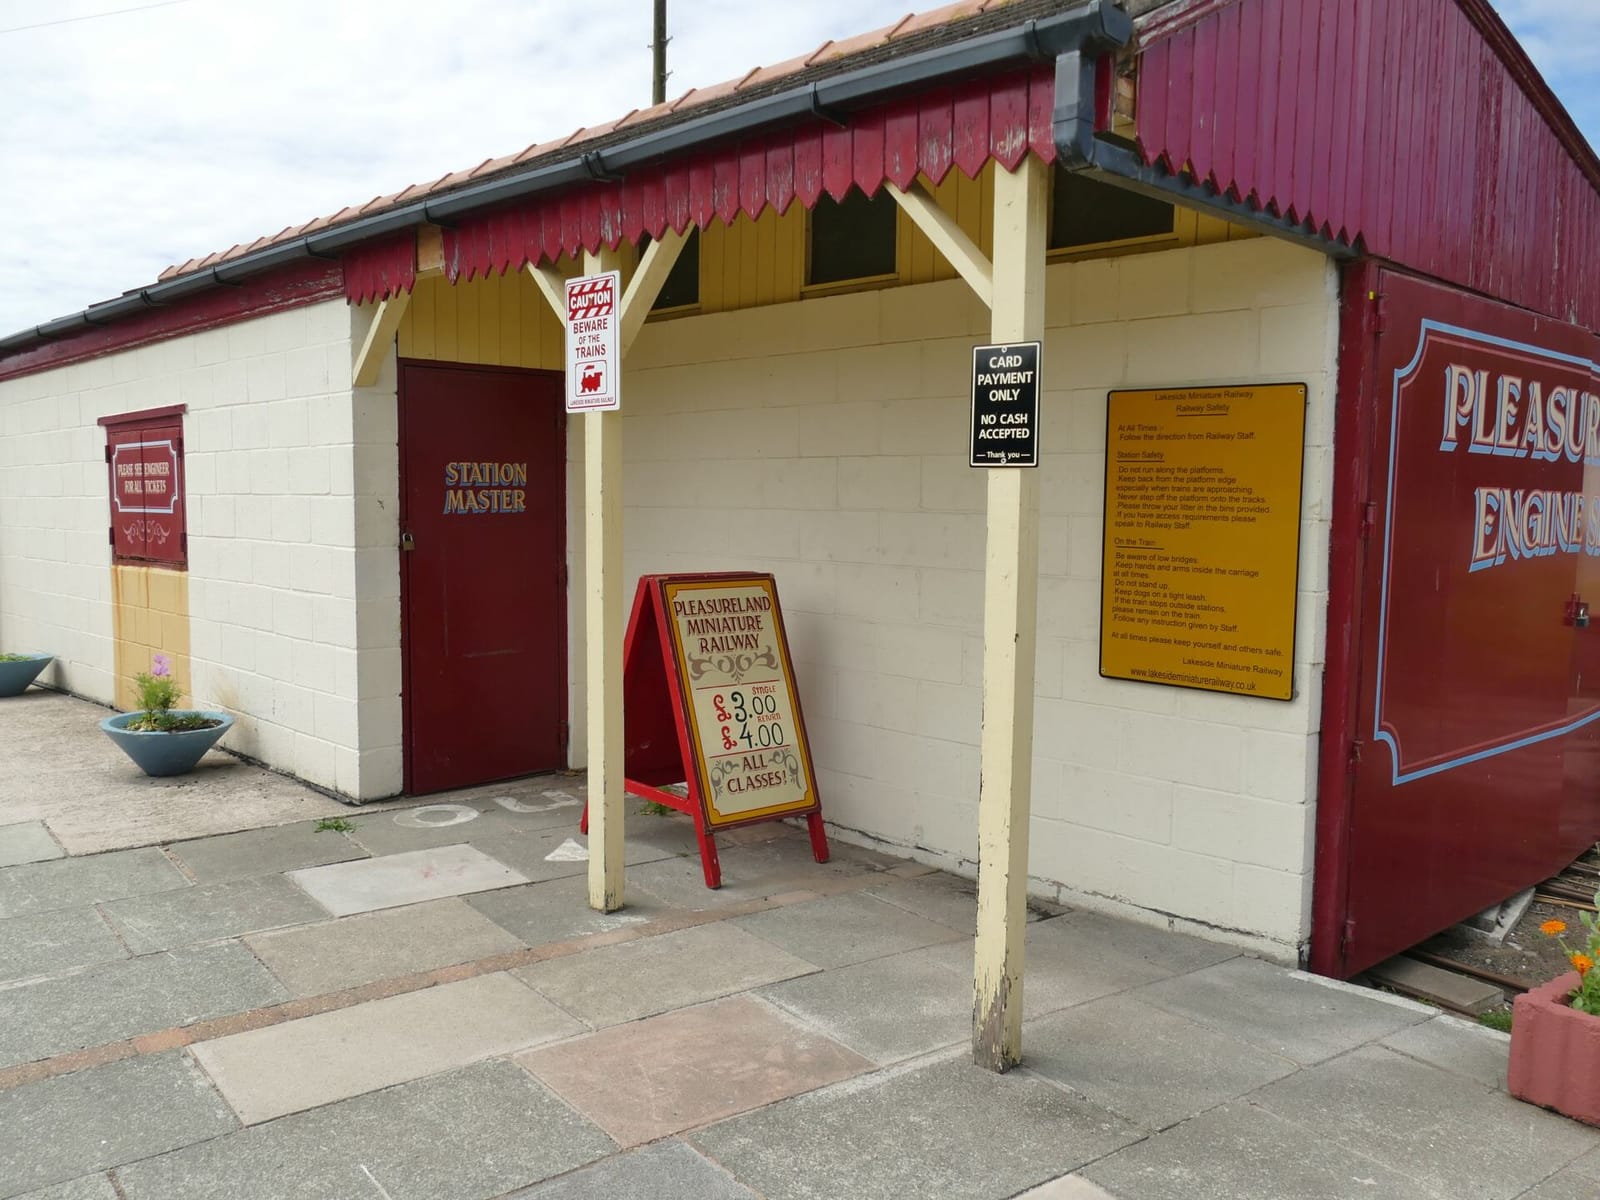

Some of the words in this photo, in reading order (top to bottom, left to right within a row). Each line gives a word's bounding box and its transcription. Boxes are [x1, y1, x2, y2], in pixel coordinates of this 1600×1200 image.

[570, 292, 611, 310] CAUTION
[573, 318, 608, 334] BEWARE
[578, 336, 587, 345] OF
[588, 334, 600, 344] THE
[576, 344, 606, 359] TRAINS
[989, 355, 1022, 368] CARD
[978, 371, 1033, 386] PAYMENT
[989, 389, 1020, 402] ONLY
[1224, 390, 1253, 400] Railway
[1176, 404, 1204, 413] Railway
[1206, 403, 1230, 412] Safety
[981, 414, 996, 424] NO
[1000, 413, 1028, 424] CASH
[978, 428, 1030, 439] ACCEPTED
[1156, 432, 1185, 440] direction
[1206, 432, 1234, 441] Railway
[1008, 452, 1020, 460] you
[1141, 451, 1164, 459] Safety
[445, 462, 528, 486] STATION
[1155, 466, 1175, 474] along
[1118, 475, 1136, 483] Keep
[1186, 476, 1216, 484] platform
[1217, 476, 1236, 484] edge
[144, 480, 167, 494] TICKETS
[1116, 484, 1148, 493] especially
[443, 490, 526, 514] MASTER
[1139, 494, 1154, 502] step
[1179, 495, 1209, 503] platform
[1182, 513, 1229, 523] requirements
[1231, 515, 1256, 523] please
[1115, 520, 1134, 529] speak
[1145, 521, 1172, 530] Railway
[1469, 486, 1584, 573] ENGINE
[1138, 538, 1155, 546] Train
[1115, 561, 1133, 570] Keep
[1228, 568, 1259, 578] carriage
[1138, 580, 1157, 588] stand
[1114, 588, 1132, 597] Keep
[1134, 589, 1150, 598] dogs
[1169, 592, 1184, 601] tight
[673, 595, 771, 617] PLEASURELAND
[1112, 605, 1133, 615] please
[1135, 607, 1159, 615] remain
[1149, 600, 1167, 609] stops
[1169, 601, 1195, 609] outside
[688, 615, 764, 636] MINIATURE
[1114, 614, 1135, 622] Follow
[1151, 618, 1186, 627] instruction
[1188, 621, 1208, 631] given
[1209, 623, 1219, 632] by
[700, 634, 760, 654] RAILWAY
[1129, 633, 1147, 641] times
[1149, 635, 1172, 645] please
[1174, 638, 1191, 647] keep
[1192, 640, 1222, 651] yourself
[1238, 644, 1263, 653] others
[1183, 657, 1214, 667] Lakeside
[1216, 661, 1251, 671] Miniature
[1252, 665, 1283, 677] Railway
[743, 754, 768, 772] ALL
[728, 770, 787, 794] CLASSES!
